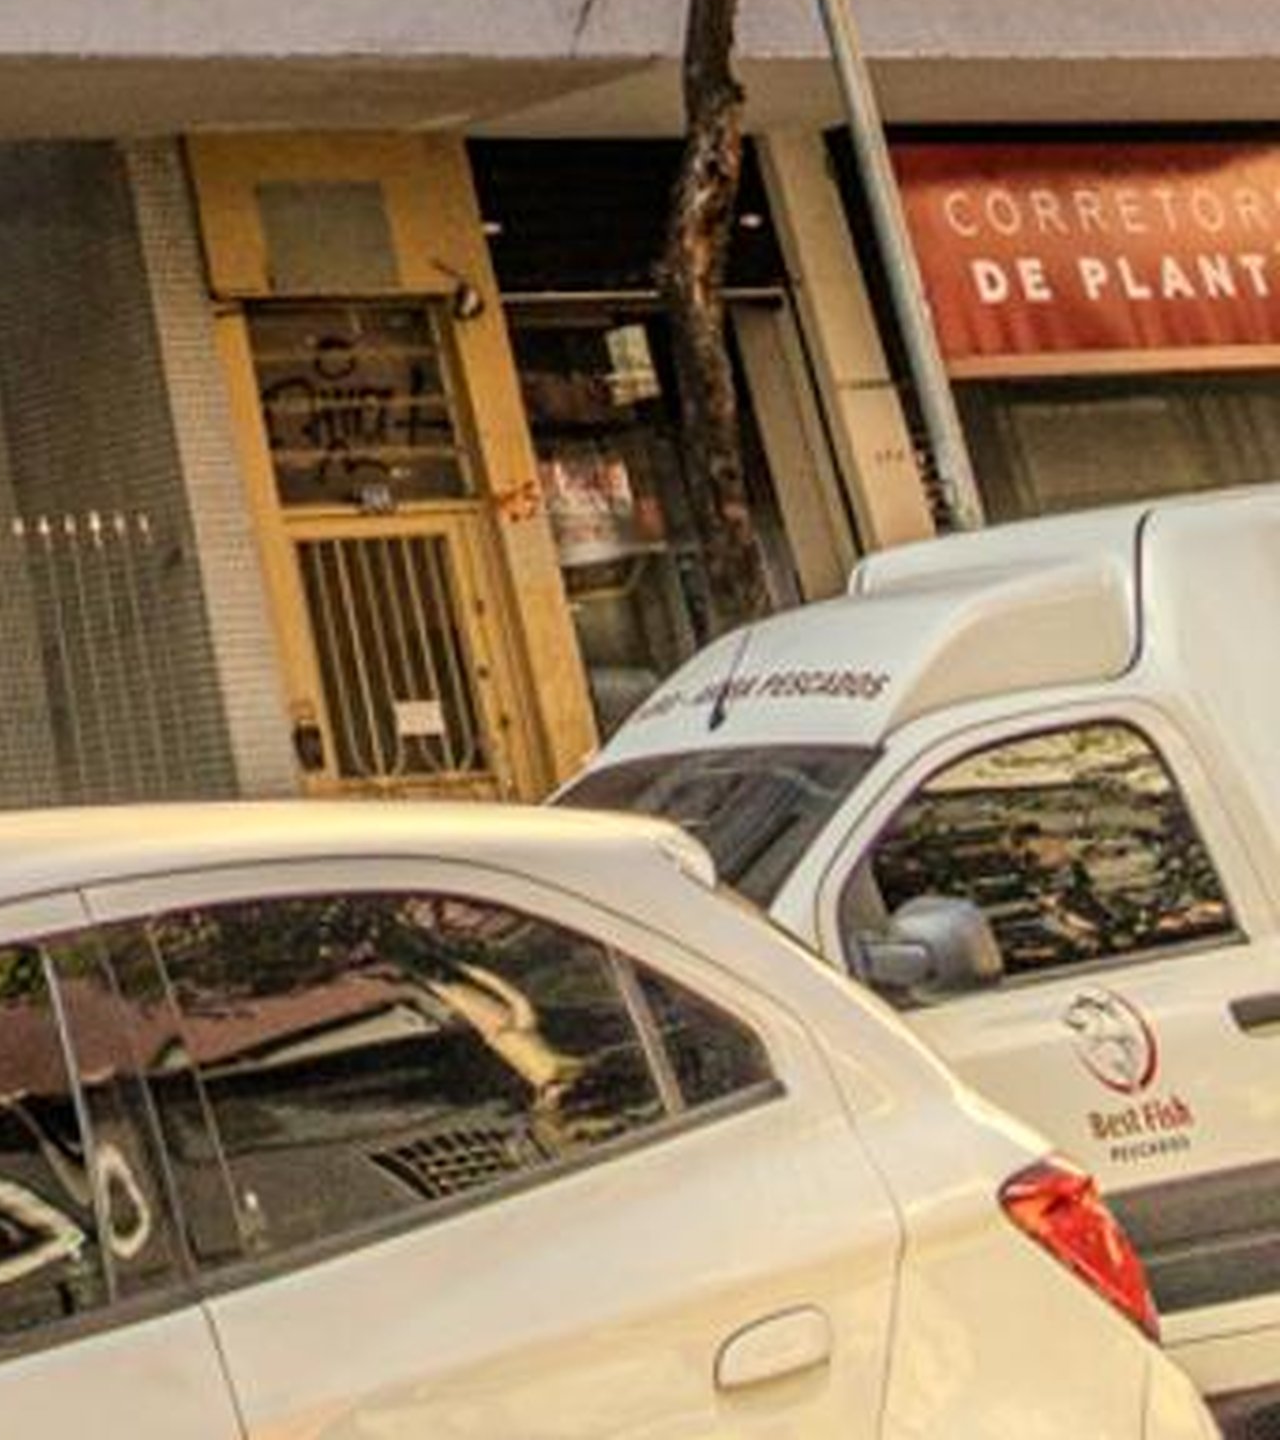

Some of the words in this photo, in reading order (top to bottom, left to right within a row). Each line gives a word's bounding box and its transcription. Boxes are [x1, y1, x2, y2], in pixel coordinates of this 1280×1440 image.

[943, 187, 1280, 238] CORRETOR
[970, 256, 1053, 304] DE
[1077, 250, 1280, 300] PLANT
[1087, 1106, 1142, 1140] Best
[1142, 1093, 1195, 1132] Fish
